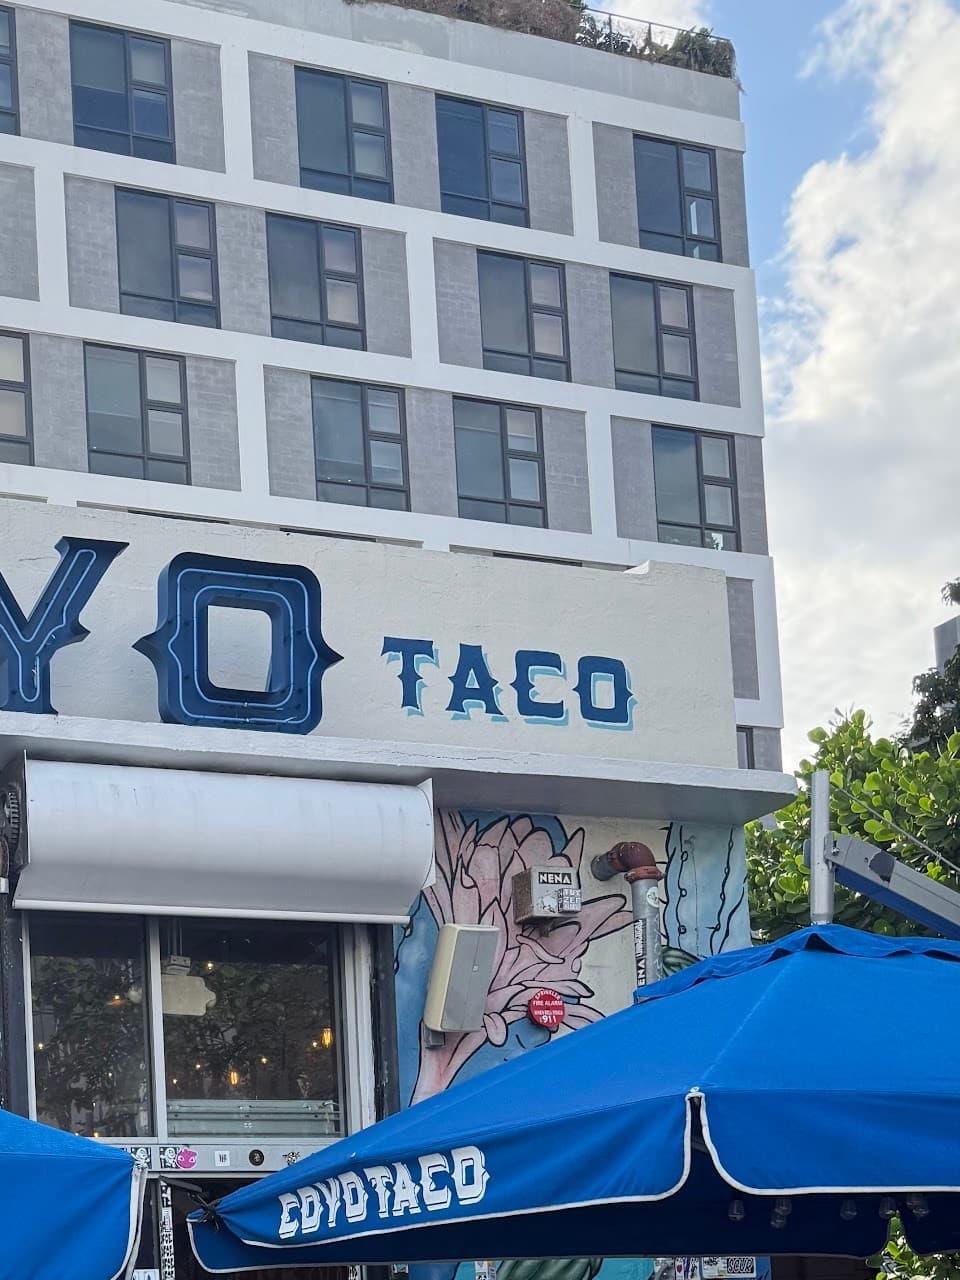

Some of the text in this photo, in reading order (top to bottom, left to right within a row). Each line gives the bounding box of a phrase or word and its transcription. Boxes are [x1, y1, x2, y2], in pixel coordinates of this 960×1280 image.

[380, 636, 638, 731] TACO
[539, 873, 571, 884] NENA
[637, 959, 645, 987] ENA
